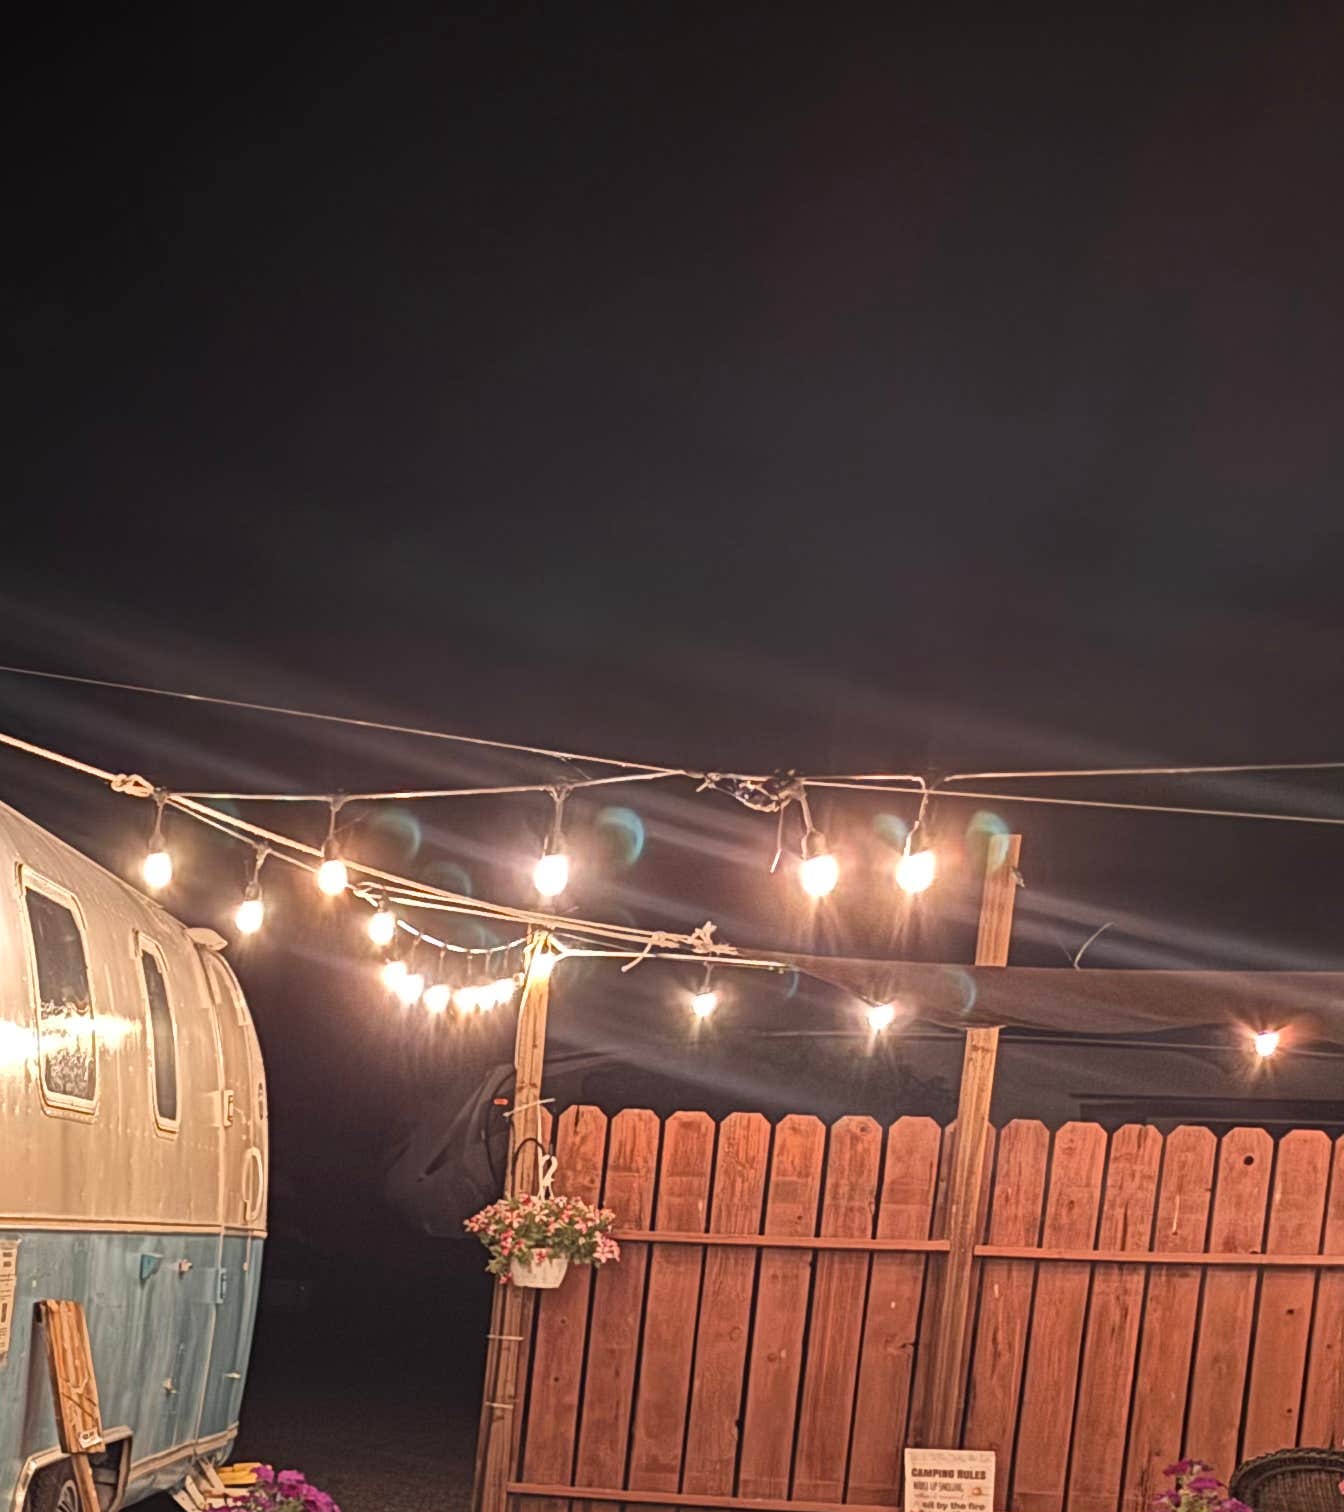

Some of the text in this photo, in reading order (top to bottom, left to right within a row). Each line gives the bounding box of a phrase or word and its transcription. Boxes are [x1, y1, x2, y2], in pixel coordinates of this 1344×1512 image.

[911, 1468, 986, 1480] CAMPING RULES
[936, 1502, 948, 1511] by
[950, 1502, 967, 1510] the
[968, 1502, 986, 1511] fire
